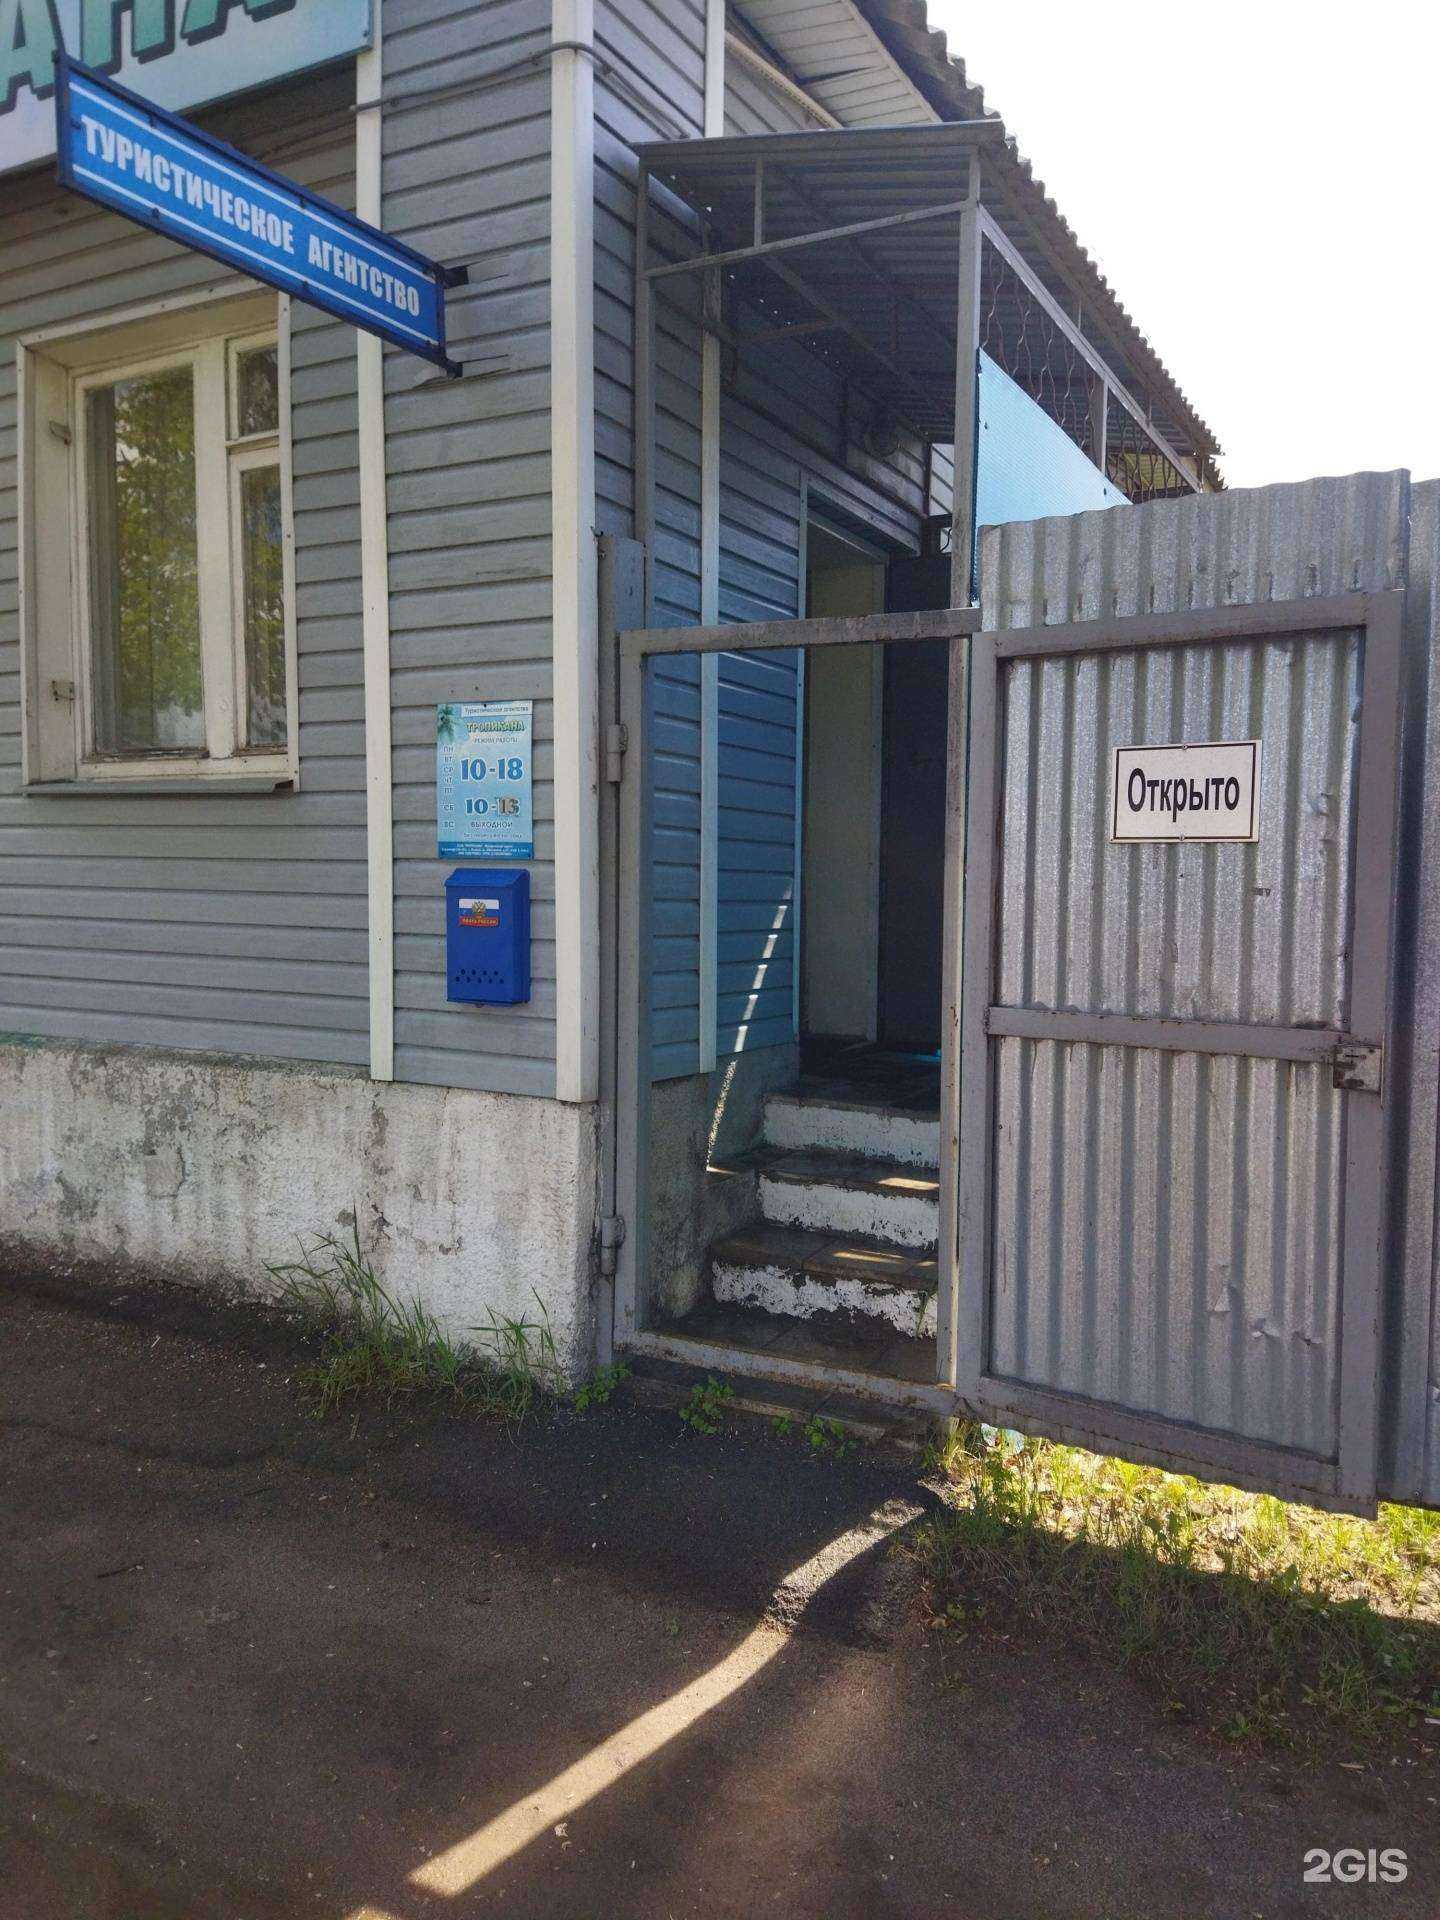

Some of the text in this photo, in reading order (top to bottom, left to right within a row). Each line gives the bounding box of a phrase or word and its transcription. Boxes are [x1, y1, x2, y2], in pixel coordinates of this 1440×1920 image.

[0, 0, 296, 116] АН
[81, 114, 420, 318] ТУРИСТИЧЕСКОЕ АГЕНТСТВО
[467, 720, 526, 733] ТРОПИКАНА
[459, 757, 524, 781] 10-18
[1128, 768, 1240, 822] Открыто
[471, 820, 513, 828] ВЫХОДНОЙ
